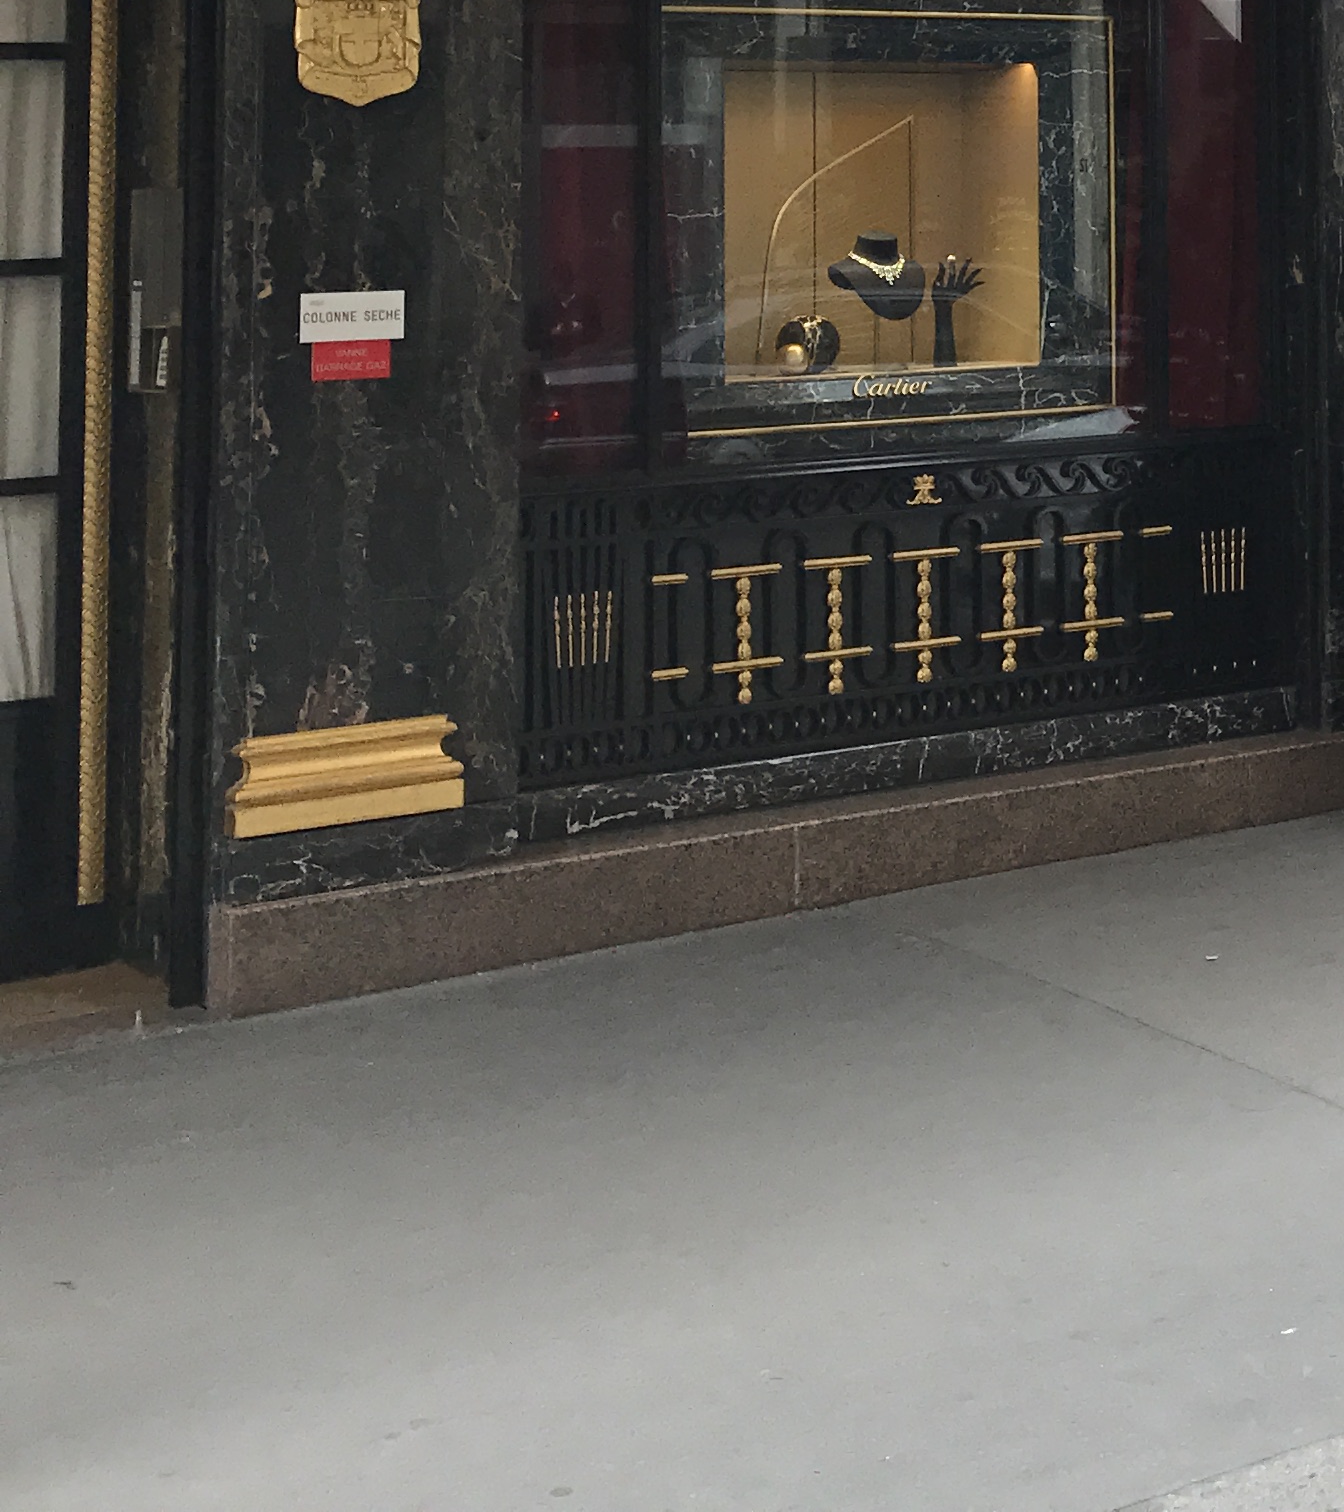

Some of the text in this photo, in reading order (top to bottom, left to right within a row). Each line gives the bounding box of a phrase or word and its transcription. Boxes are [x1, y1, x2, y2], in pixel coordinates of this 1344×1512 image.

[303, 308, 401, 324] COLONNE SECHE
[852, 374, 933, 399] Cartier
